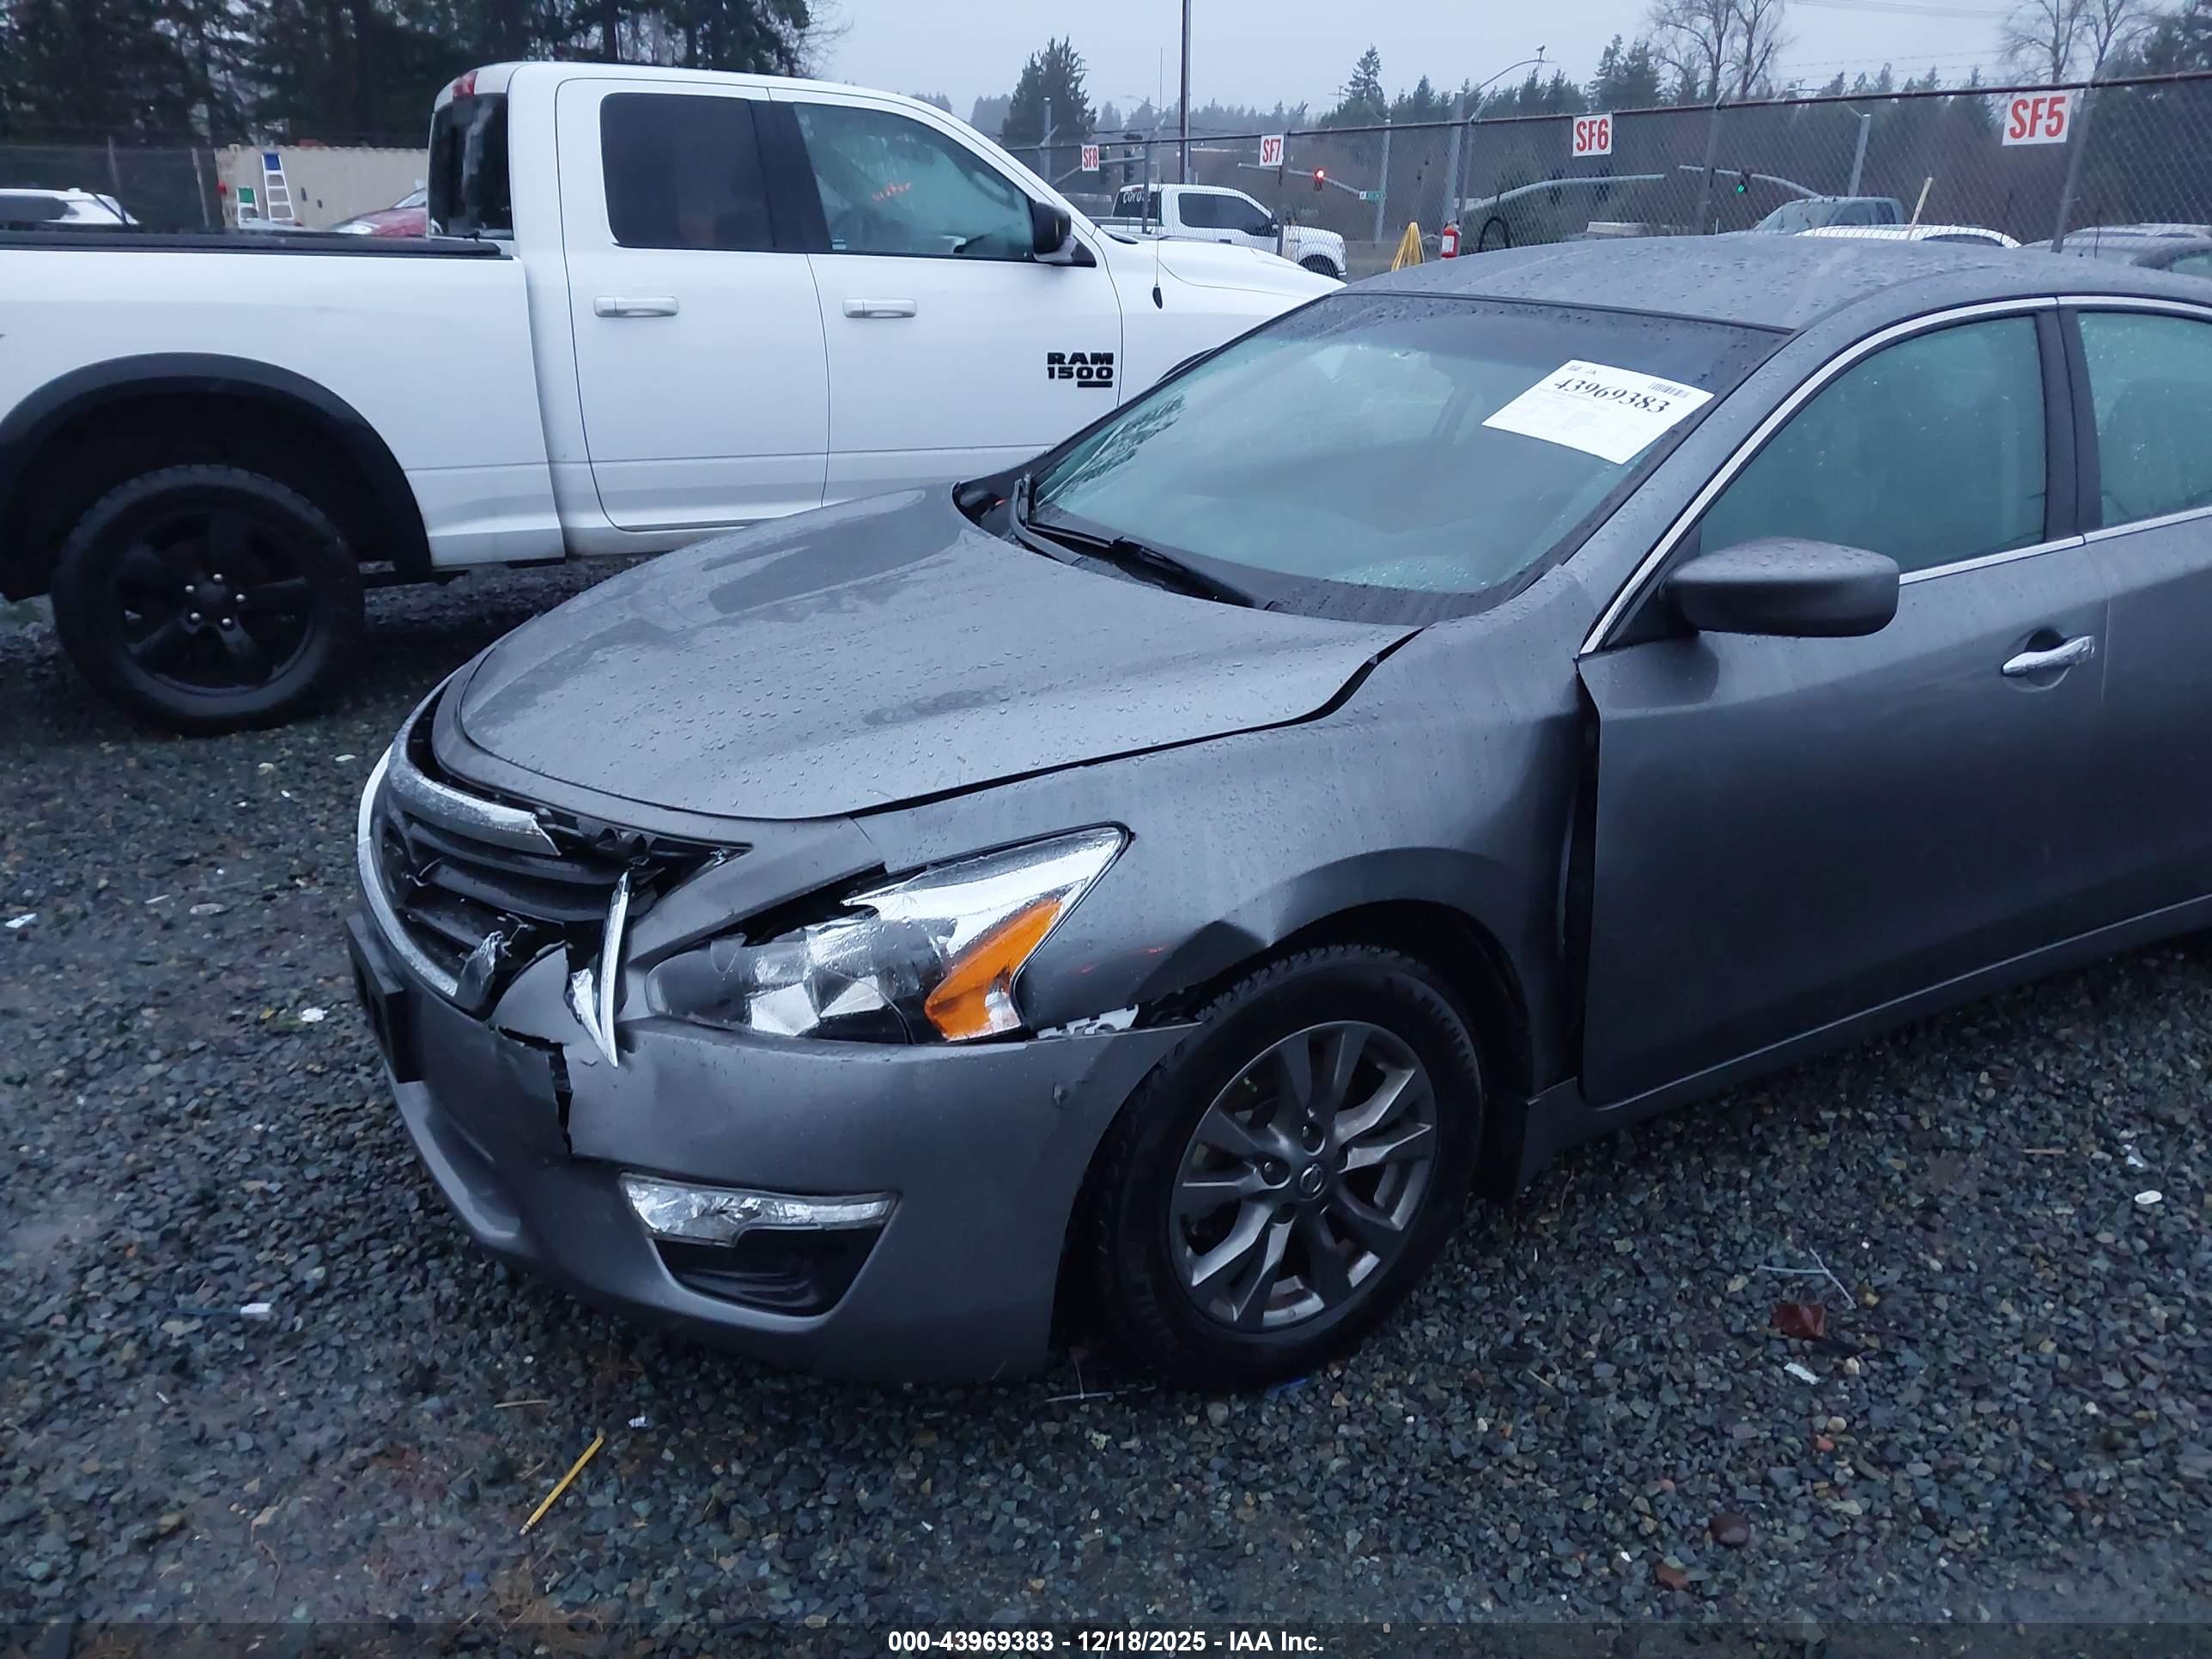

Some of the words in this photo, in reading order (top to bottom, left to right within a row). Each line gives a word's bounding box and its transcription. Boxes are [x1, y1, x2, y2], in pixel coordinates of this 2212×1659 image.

[2009, 96, 2066, 138] SF5
[1576, 118, 1609, 151] SF6
[1084, 147, 1098, 168] SF8
[1263, 138, 1281, 163] SF7
[1047, 352, 1115, 365] RAM
[1047, 366, 1115, 380] 1500
[1554, 378, 1671, 413] 43969383
